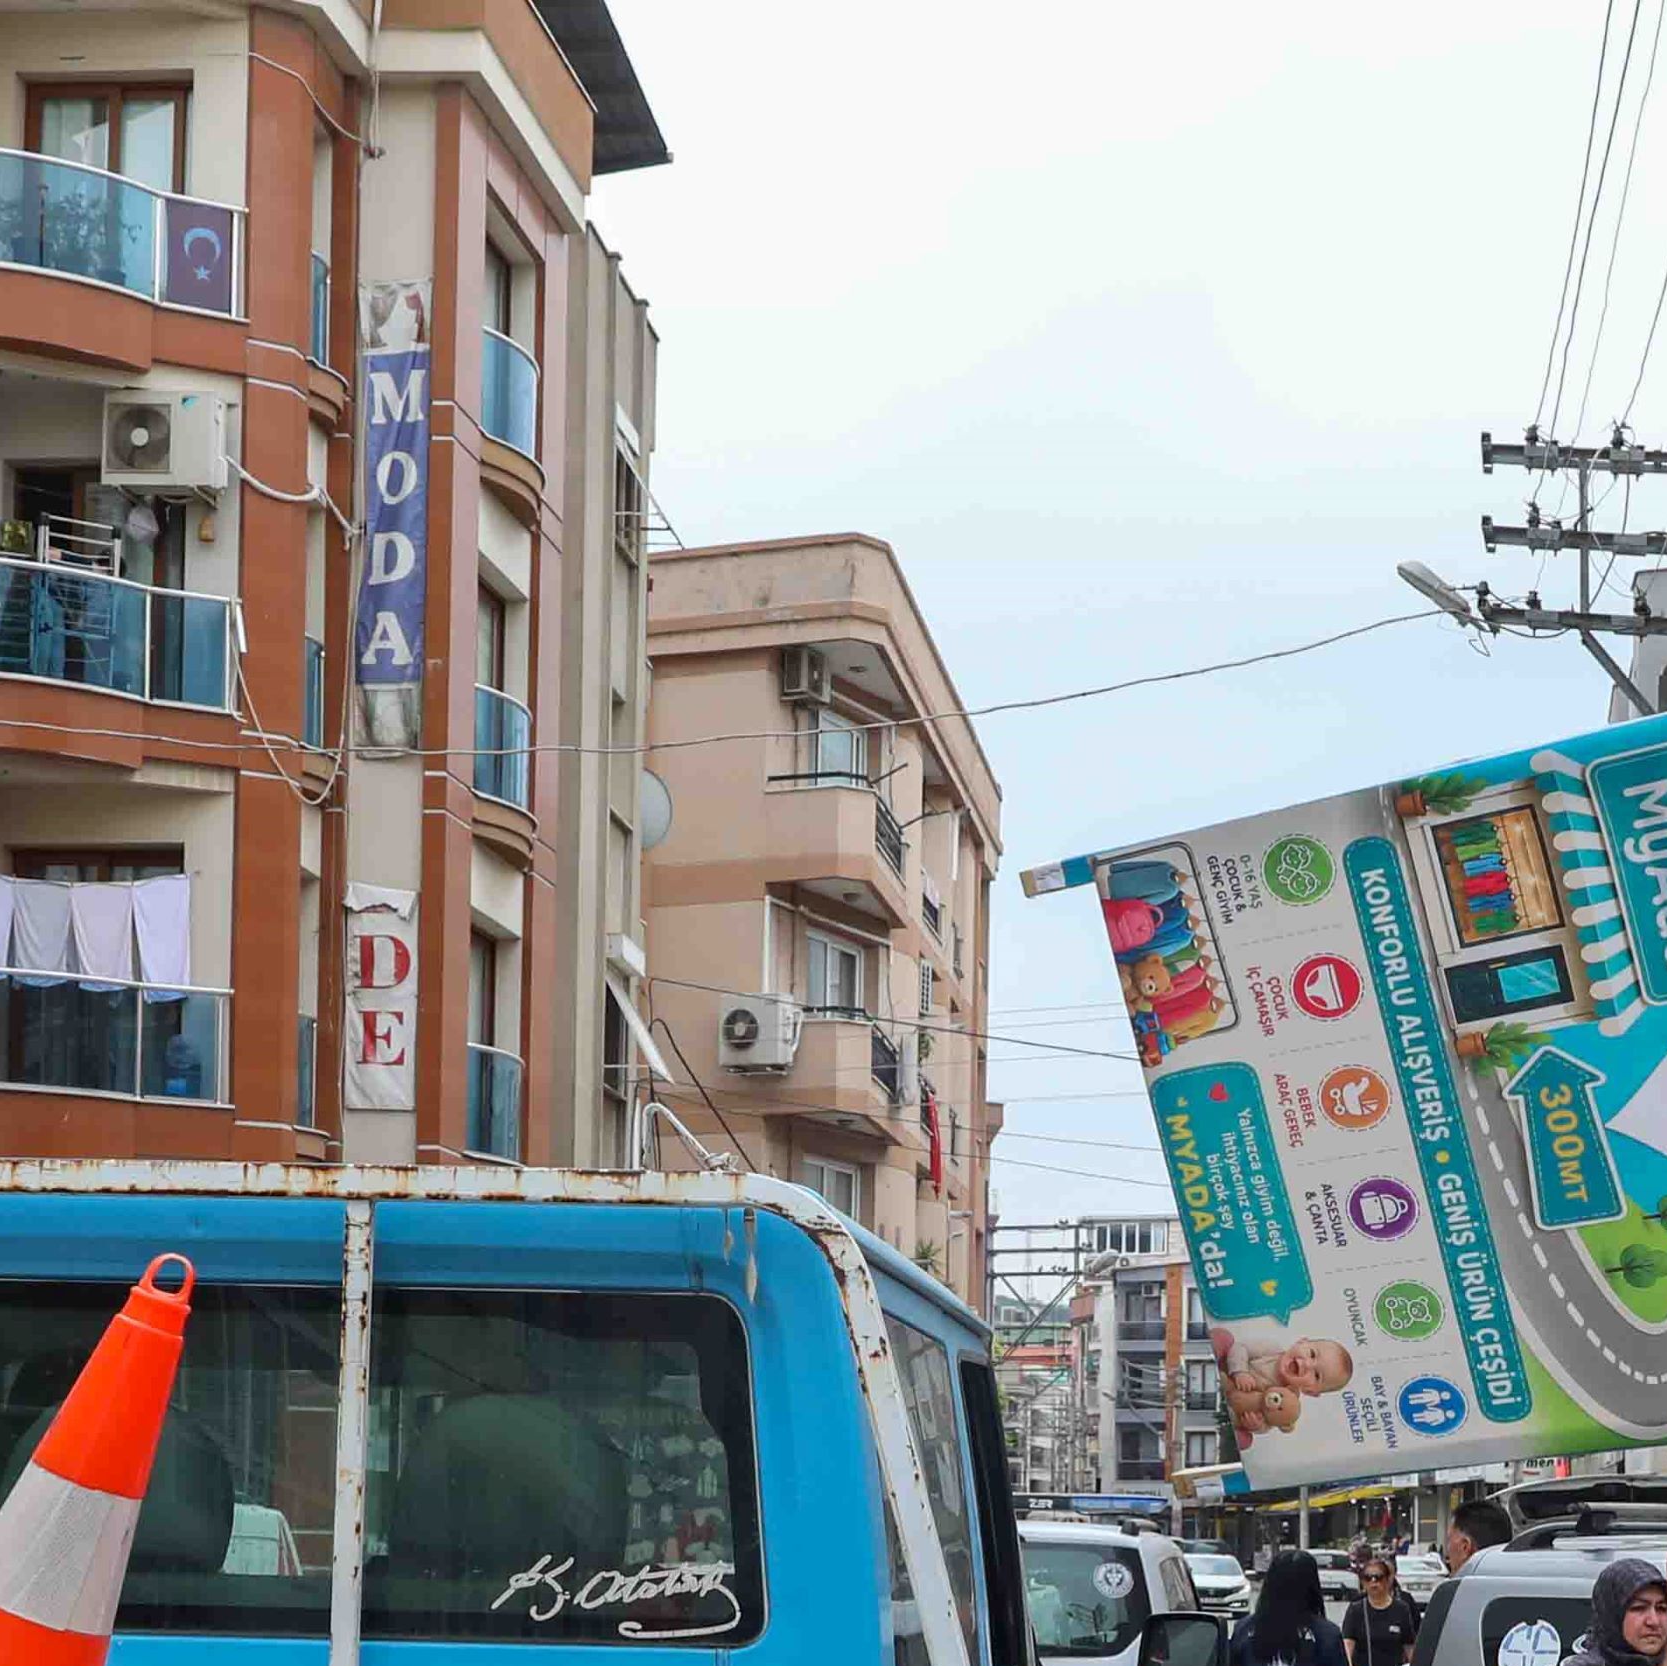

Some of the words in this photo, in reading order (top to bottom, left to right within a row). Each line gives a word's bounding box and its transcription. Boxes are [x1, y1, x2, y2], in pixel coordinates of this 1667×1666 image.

[362, 368, 426, 667] MODA
[1206, 855, 1224, 888] GENÇ
[1216, 891, 1234, 925] GİYİM
[1221, 858, 1244, 901] ÇOCUK
[1239, 854, 1256, 883] 0-16
[1246, 887, 1263, 910] YAŞ
[1248, 981, 1275, 1037] ÇAMAŞIR
[1266, 976, 1289, 1021] ÇOCUK
[1360, 867, 1418, 1007] KONFORLU
[1396, 1012, 1455, 1142] ALIŞVERİŞ
[1273, 1073, 1292, 1105] ARAÇ
[1284, 1110, 1304, 1149] GEREÇ
[1296, 1087, 1317, 1129] BEBEK
[1539, 1083, 1589, 1203] 300MT
[1206, 1153, 1232, 1202] birçok
[1221, 1131, 1252, 1210] ihtiyacınız
[1241, 1211, 1261, 1244] olan
[1237, 1107, 1262, 1171] Yalnızca
[1251, 1174, 1275, 1217] giyim
[1265, 1219, 1290, 1264] değil,
[1217, 1203, 1235, 1230] şey
[1306, 1203, 1329, 1245] ÇANTA
[1320, 1183, 1347, 1248] AKSESUAR
[1437, 1172, 1480, 1246] GENİŞ
[1343, 1287, 1368, 1347] OYUNCAK
[1457, 1250, 1497, 1322] ÜRÜN
[1469, 1326, 1522, 1407] ÇEŞİDİ
[1342, 1391, 1365, 1444] ÜRÜNLER
[1360, 1398, 1381, 1433] SEÇİLİ
[1370, 1376, 1385, 1398] BAY
[1380, 1411, 1399, 1449] BAYAN
